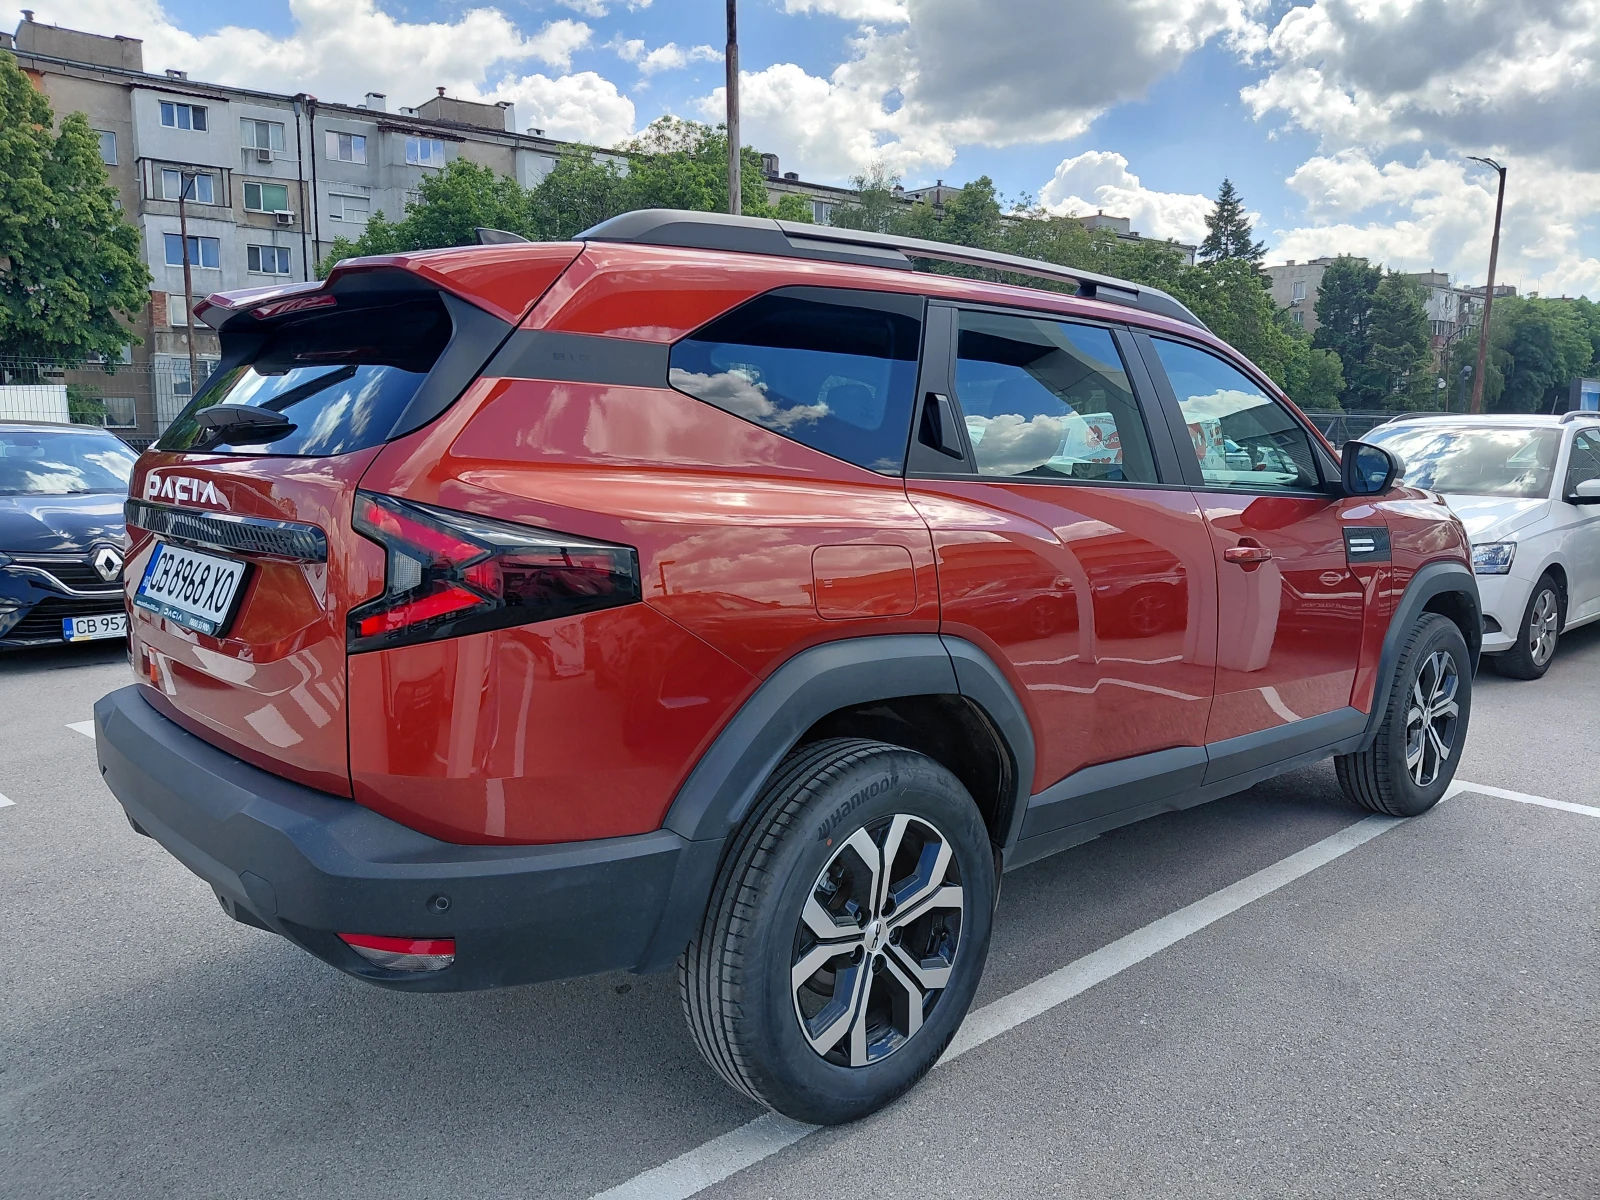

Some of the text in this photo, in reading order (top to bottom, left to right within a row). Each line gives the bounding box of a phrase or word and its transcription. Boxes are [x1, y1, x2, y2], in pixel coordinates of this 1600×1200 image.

[149, 475, 218, 505] DACIA
[149, 552, 235, 613] CB 8968 XO
[163, 607, 183, 622] DACIA
[76, 619, 97, 634] CB
